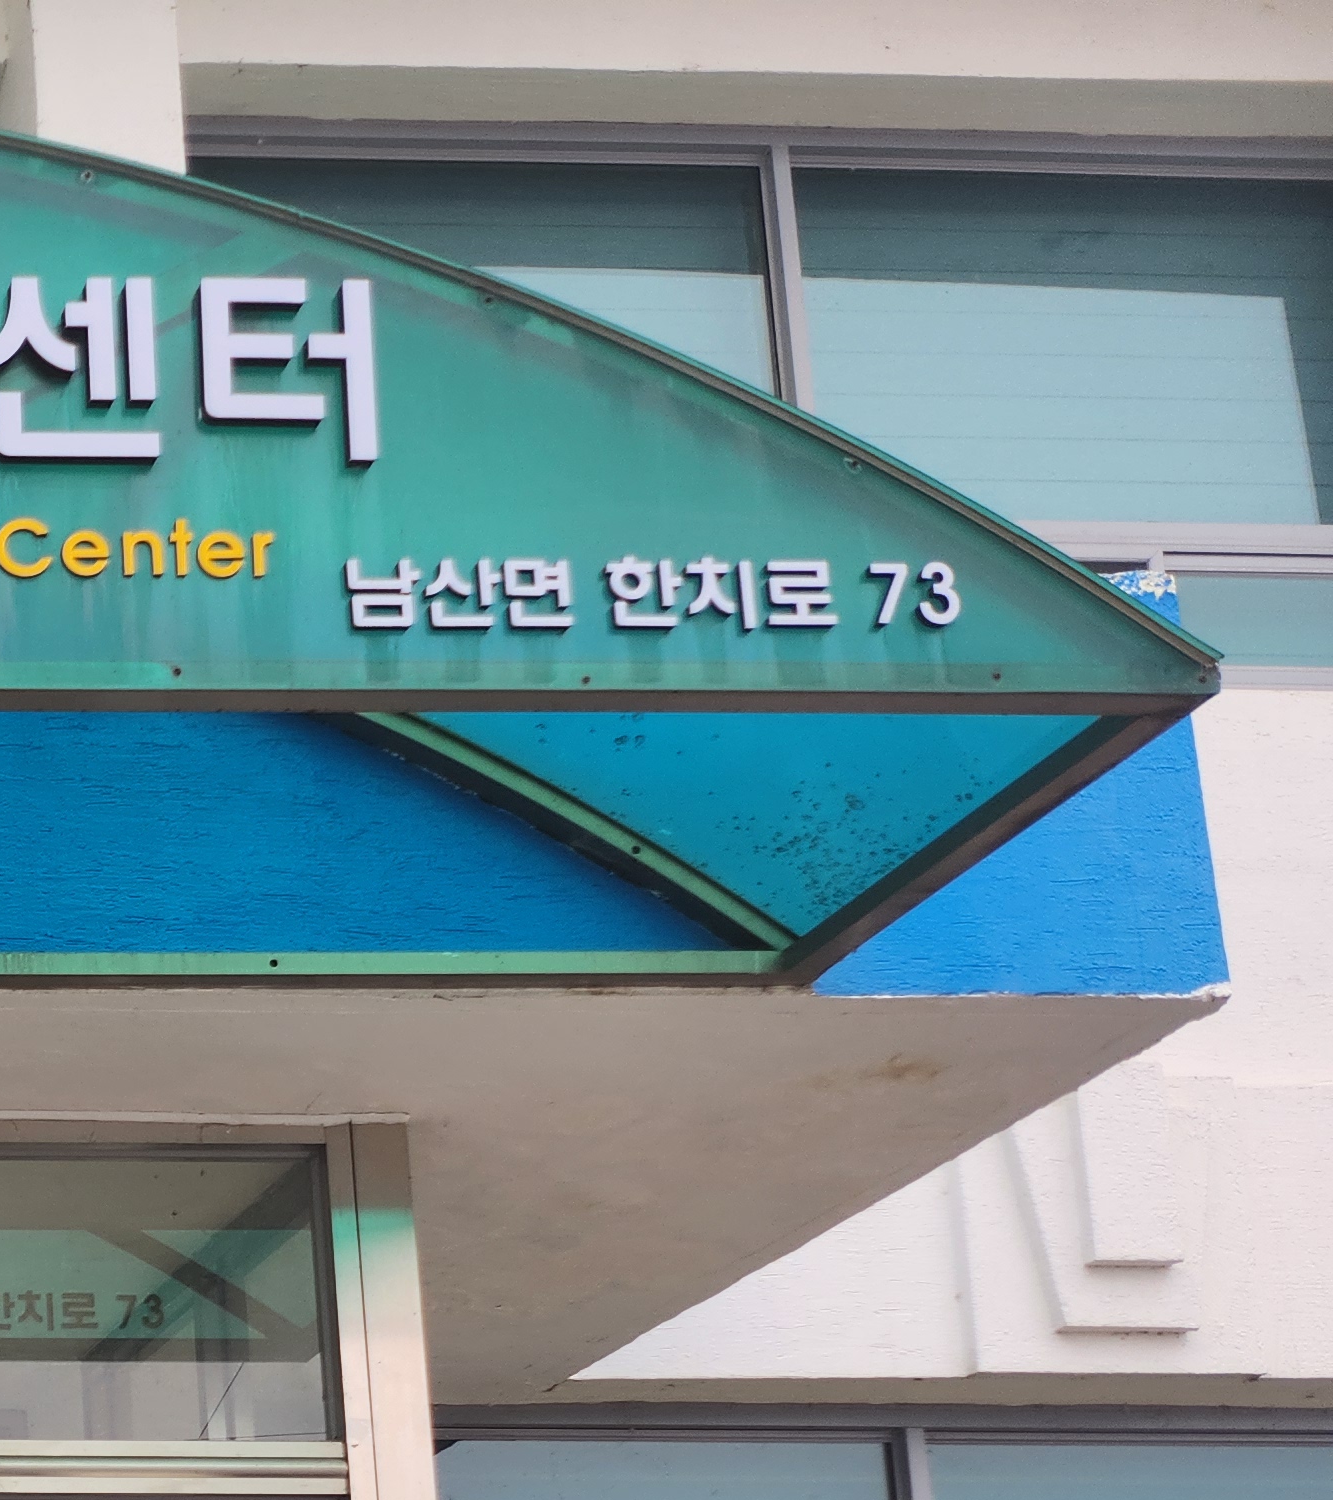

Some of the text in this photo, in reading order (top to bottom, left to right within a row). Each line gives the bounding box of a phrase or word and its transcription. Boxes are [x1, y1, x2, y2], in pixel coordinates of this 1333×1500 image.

[344, 556, 962, 630] 남산면 한치로 73
[115, 1293, 166, 1330] 73
